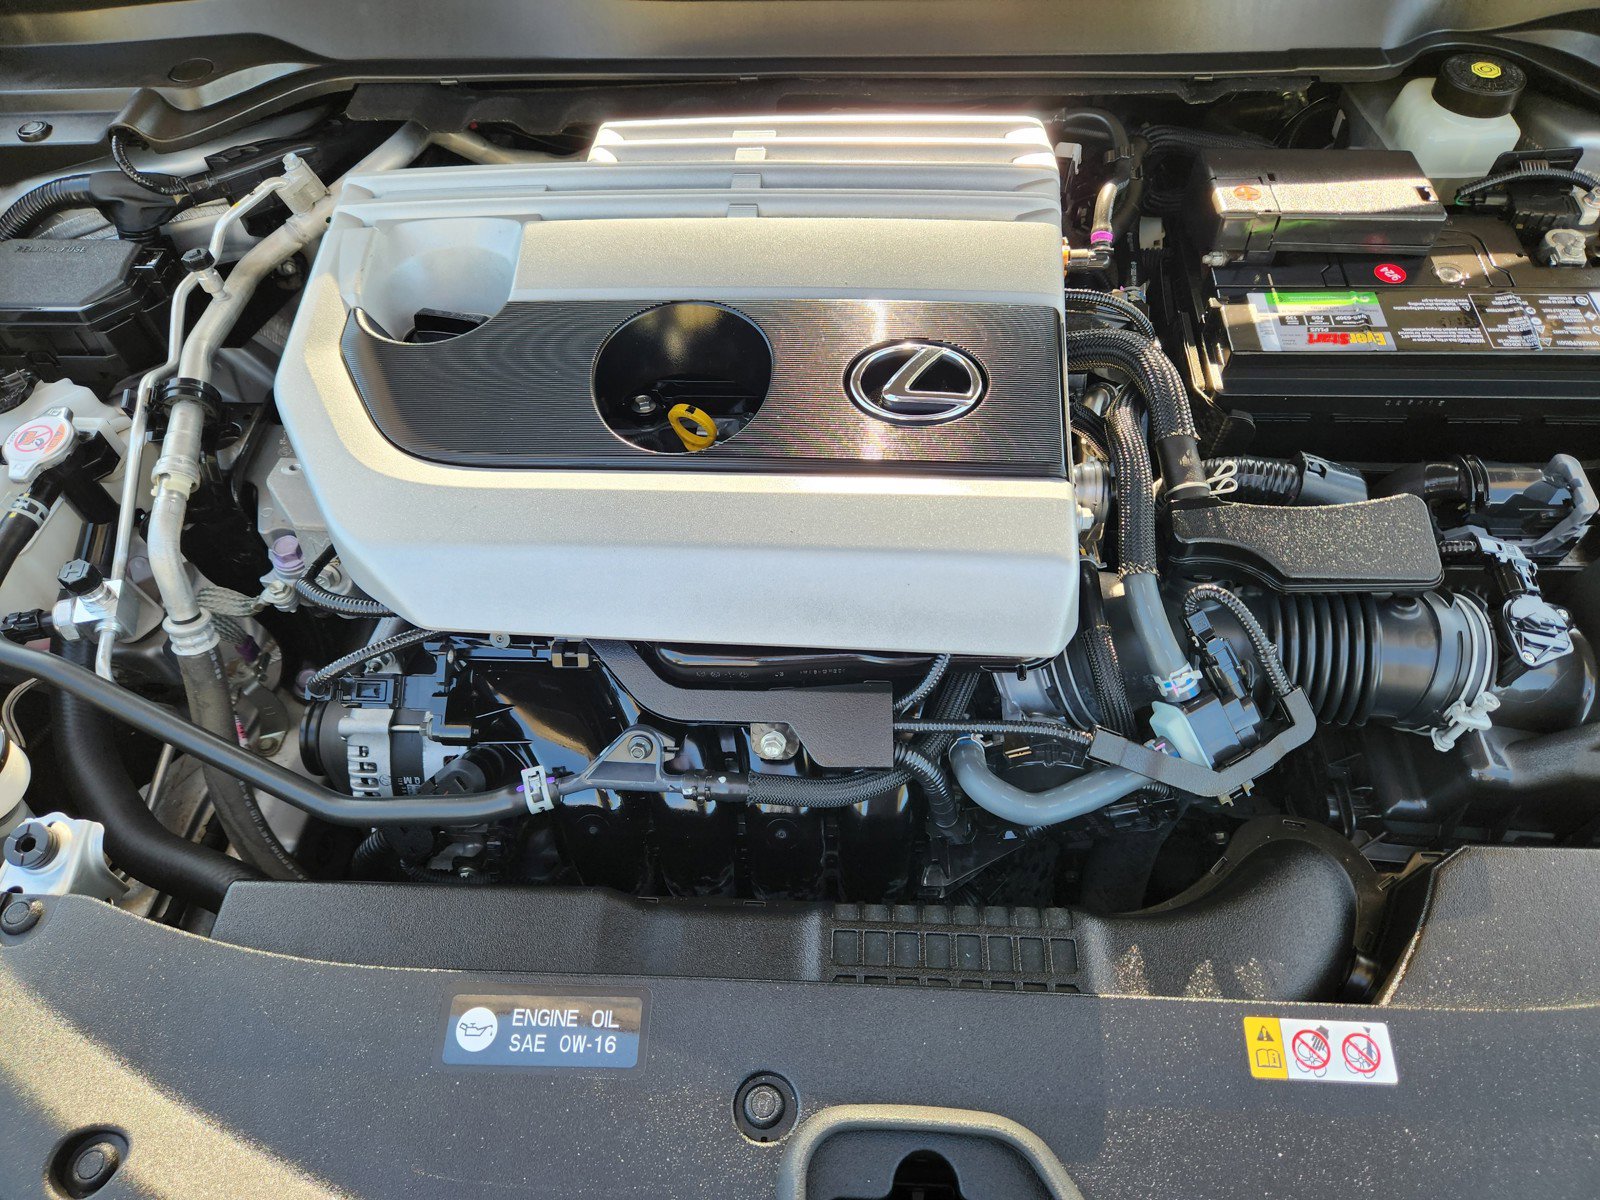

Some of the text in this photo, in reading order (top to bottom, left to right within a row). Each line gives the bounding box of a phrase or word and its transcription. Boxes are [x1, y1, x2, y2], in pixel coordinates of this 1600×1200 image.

[1308, 332, 1387, 345] EverStart
[512, 1008, 619, 1028] ENGINE OIL
[509, 1034, 617, 1054] SAE 0W-16
